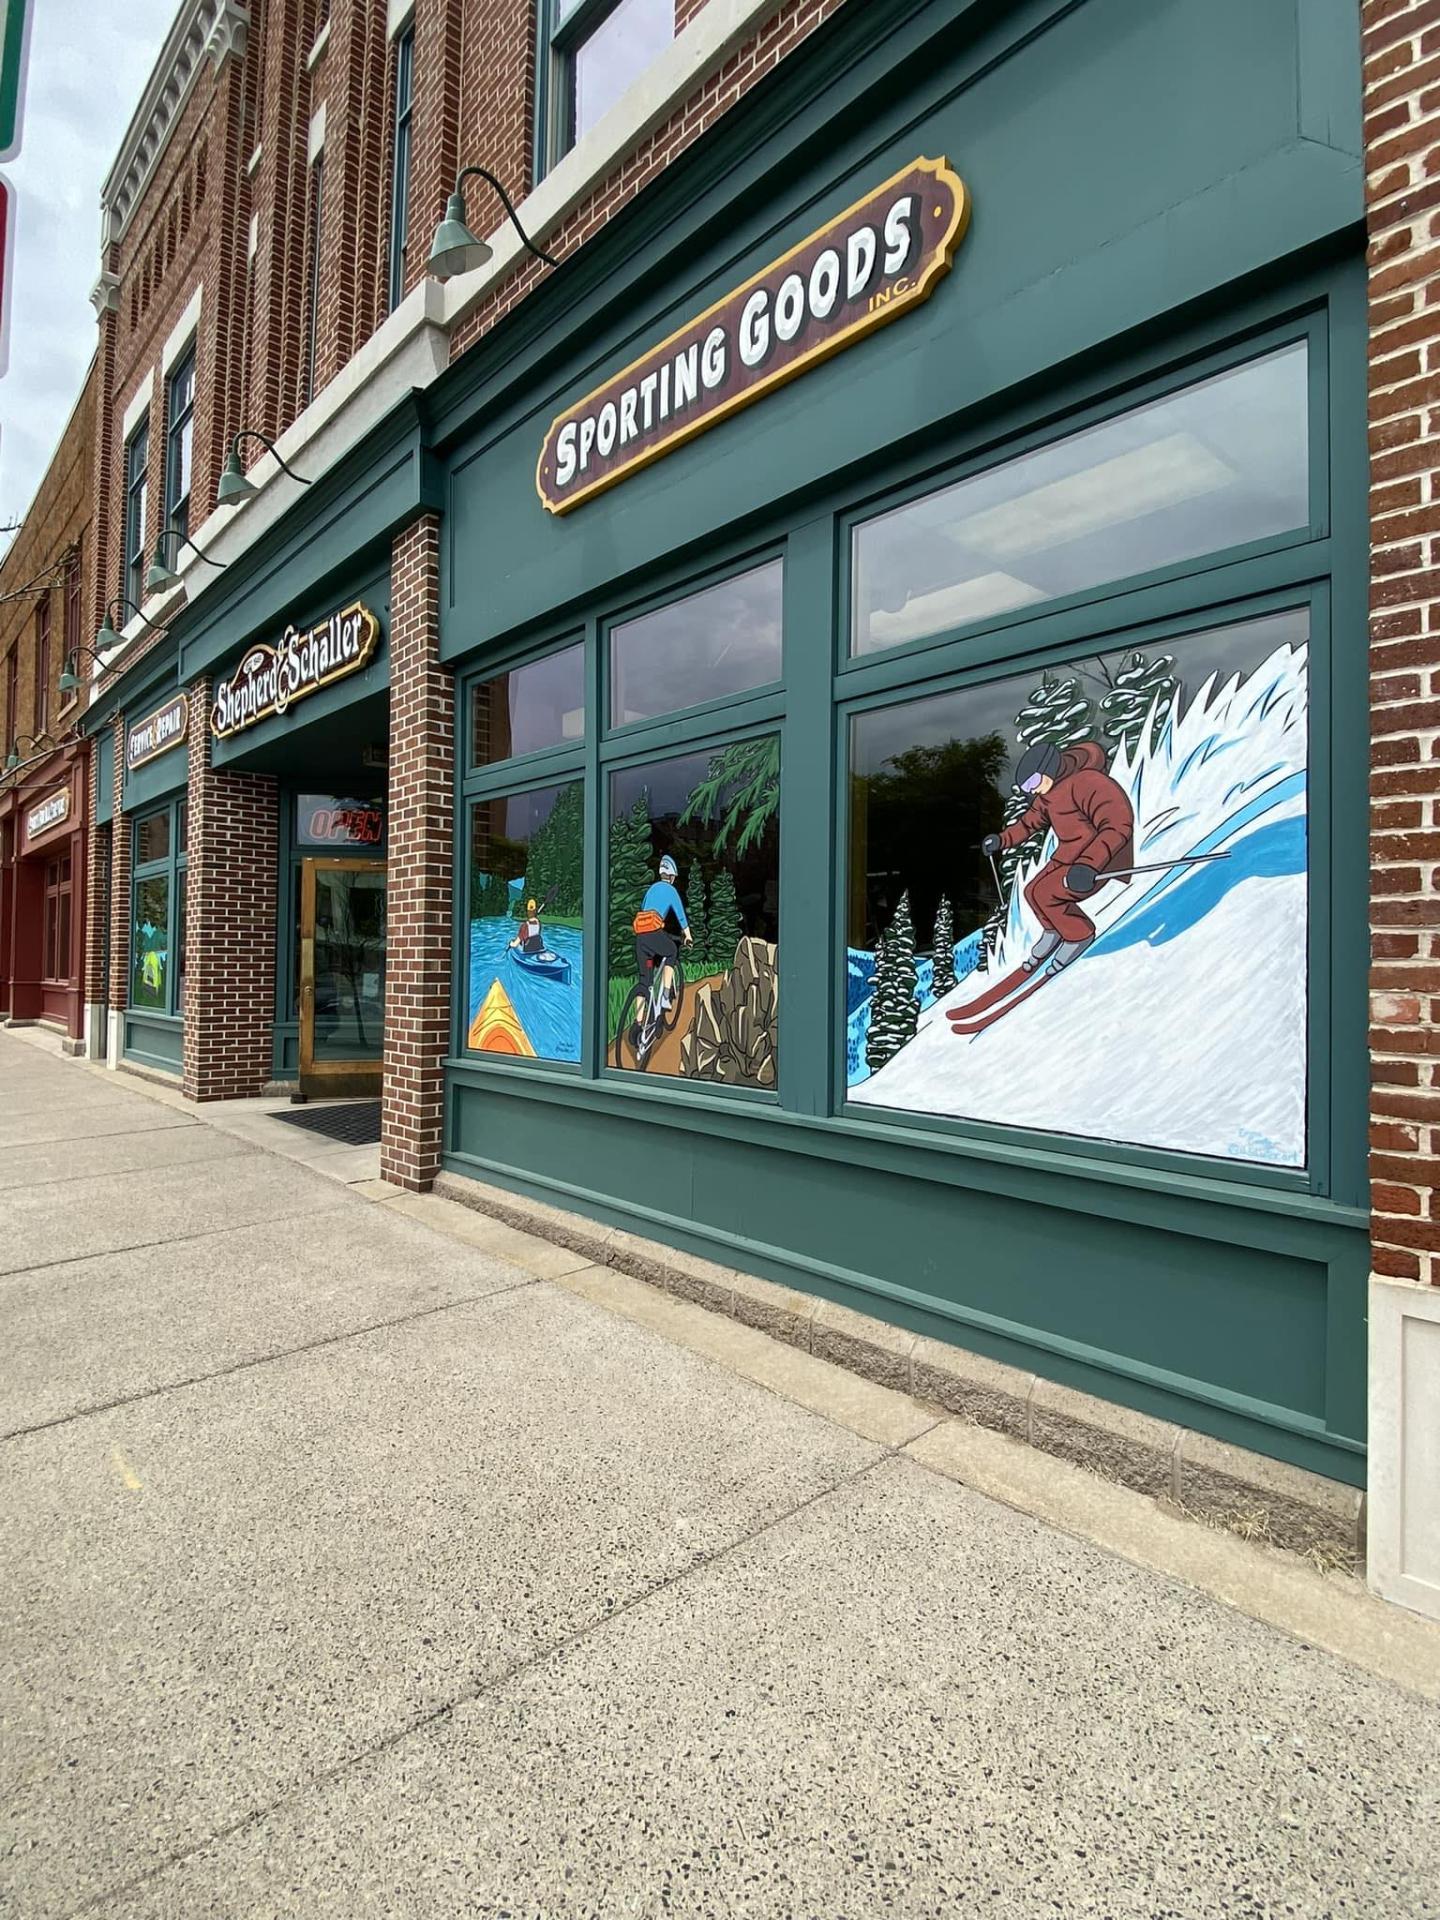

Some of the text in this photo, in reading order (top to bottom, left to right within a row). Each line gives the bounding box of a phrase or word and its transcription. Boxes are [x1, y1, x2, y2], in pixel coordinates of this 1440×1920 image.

[868, 277, 916, 313] INC.
[555, 197, 912, 486] SPORTING GOODS
[217, 655, 277, 731] Shepherd
[288, 613, 362, 691] Schaller
[310, 810, 382, 841] OPEN
